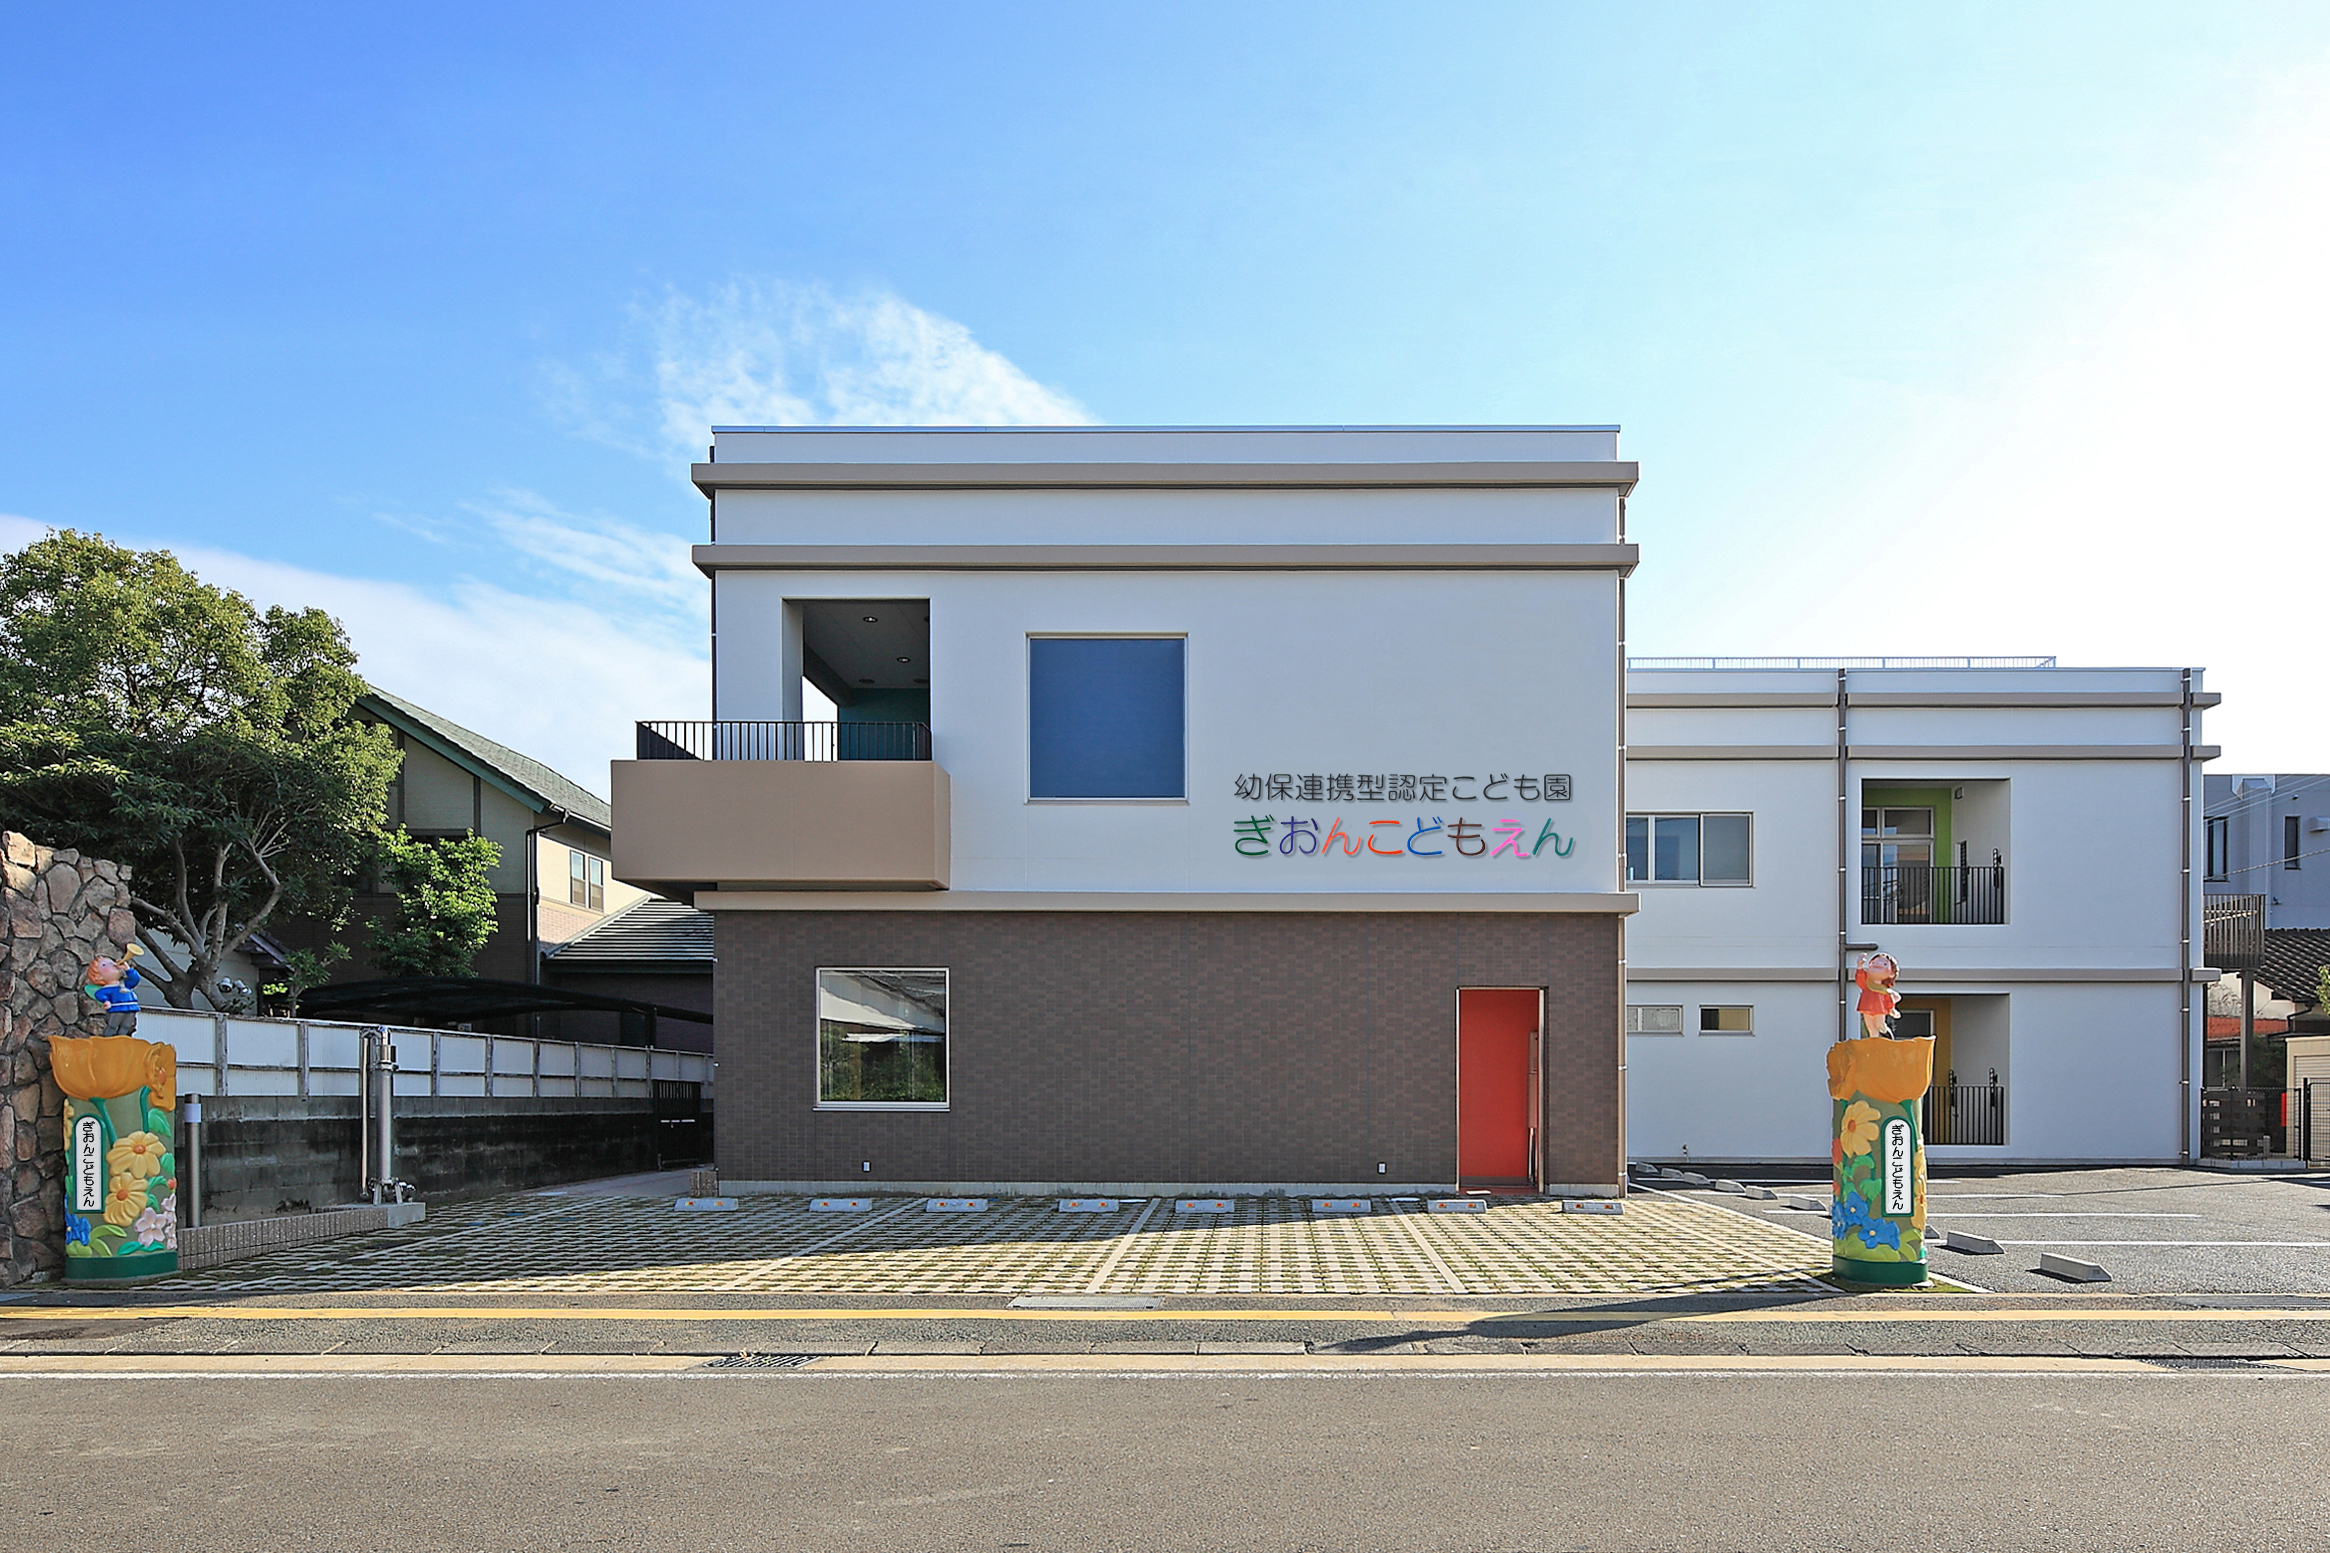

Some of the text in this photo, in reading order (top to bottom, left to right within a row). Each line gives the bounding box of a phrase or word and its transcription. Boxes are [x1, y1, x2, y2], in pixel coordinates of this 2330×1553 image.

[1234, 773, 1573, 802] 幼保連携型認定こども園
[1233, 814, 1574, 857] ぎおんこどもえん
[82, 1120, 95, 1207] ぎおんこどもえん
[1891, 1123, 1904, 1210] ぎおんこどもえん
